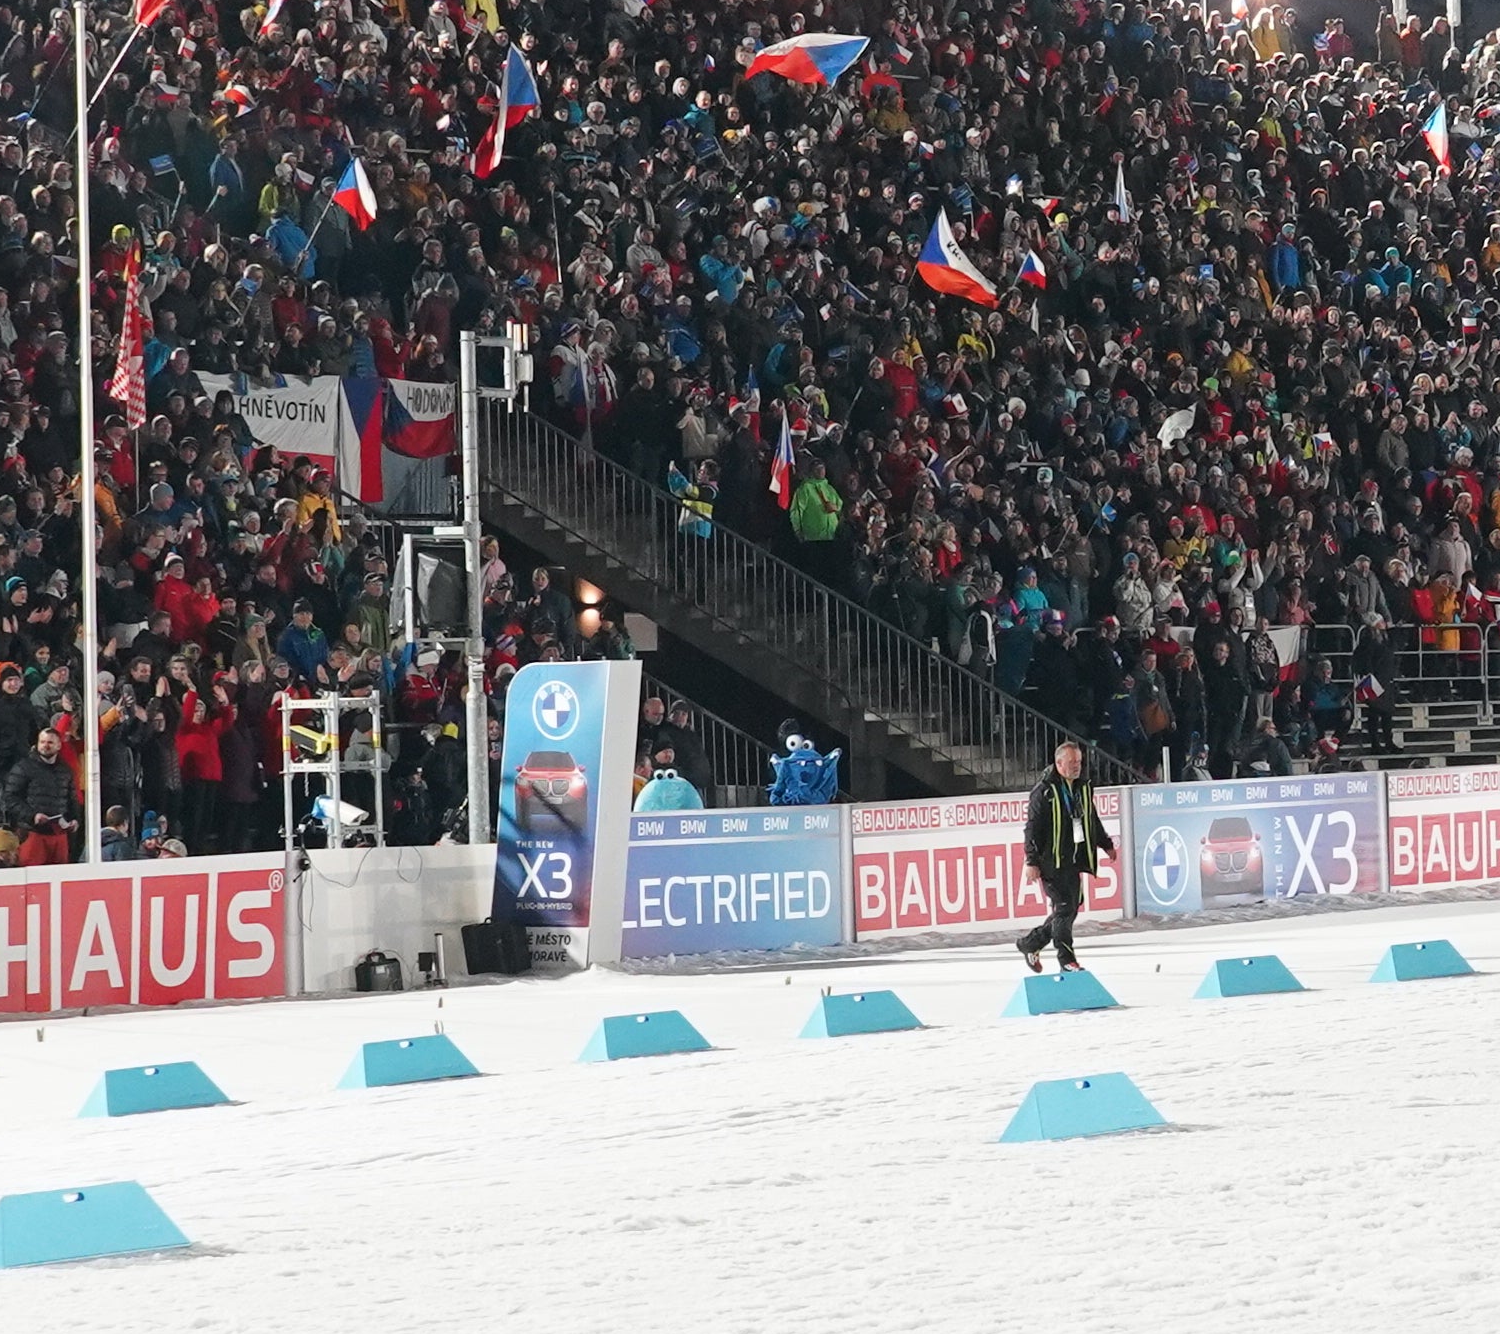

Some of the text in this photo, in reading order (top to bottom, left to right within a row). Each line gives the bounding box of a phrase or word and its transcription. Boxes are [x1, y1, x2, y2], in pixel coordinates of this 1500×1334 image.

[239, 395, 326, 424] HNĚVOTÍN
[1140, 780, 1368, 807] BMW BMW BMW BMW BMW BMW BMW
[1397, 774, 1461, 797] BAUHAUS
[637, 814, 830, 837] BMW BMW BMW BMW BMW
[865, 807, 940, 831] BAUHAUS
[515, 839, 554, 849] THE NEW
[1148, 830, 1183, 853] BMW
[1285, 810, 1358, 898] X3
[1274, 817, 1283, 899] THE NEW
[516, 852, 574, 900] X3
[859, 854, 1118, 920] BAUHAS
[621, 870, 832, 929] ECTRIFIED
